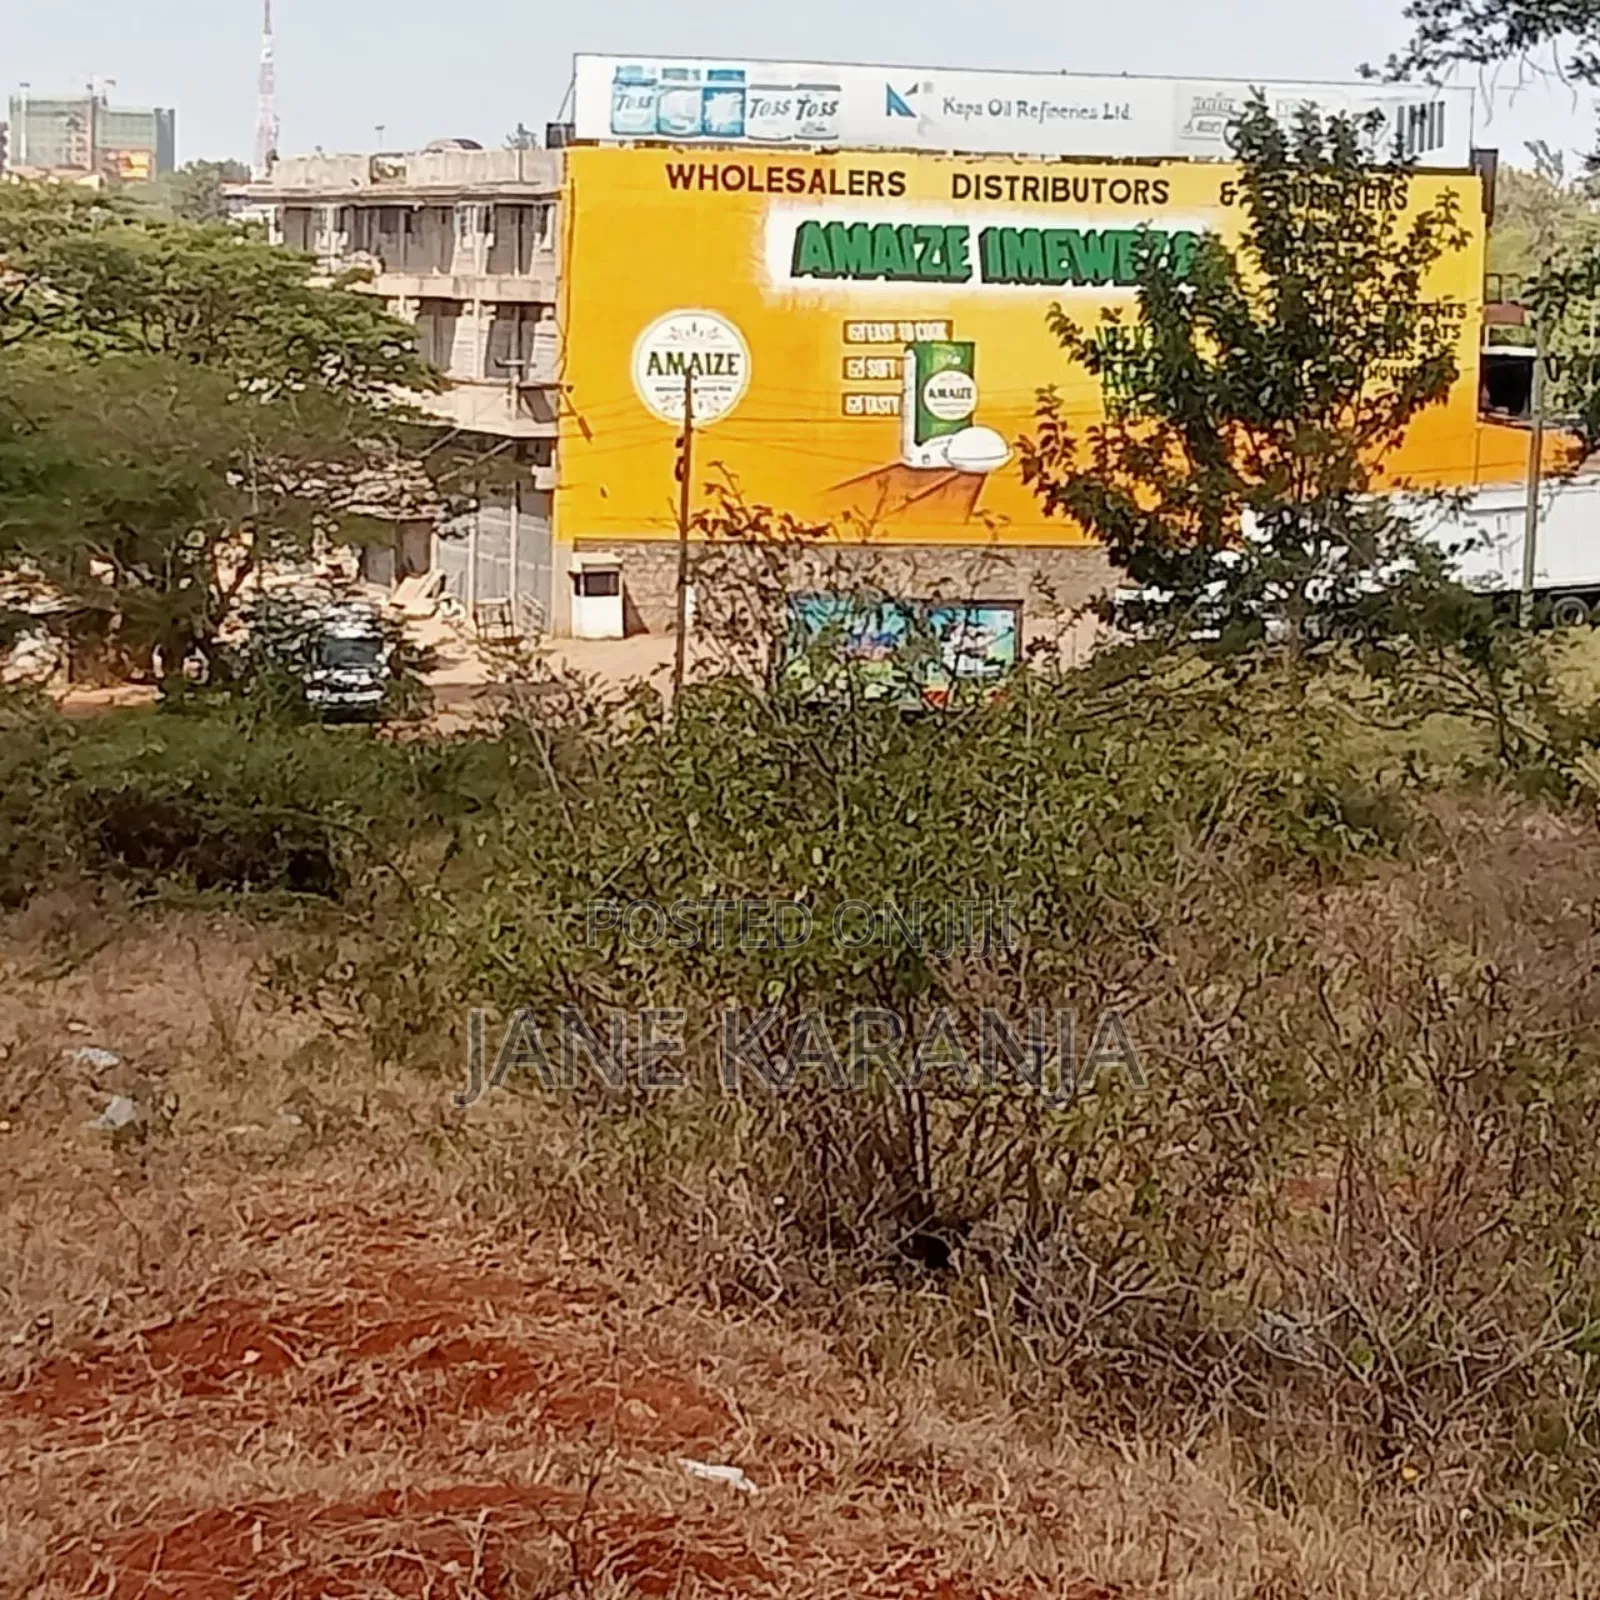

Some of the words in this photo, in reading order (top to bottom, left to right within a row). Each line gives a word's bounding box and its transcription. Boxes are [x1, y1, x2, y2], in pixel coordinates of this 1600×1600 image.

[943, 97, 983, 122] Kapa
[988, 98, 1012, 117] Oil
[1016, 100, 1098, 124] Refineries
[666, 163, 907, 197] WHOLESALERS
[952, 174, 1170, 205] DISTRIBUTORS
[1219, 181, 1238, 206] &
[790, 220, 973, 283] AMAIZE
[646, 350, 741, 376] AMAIZE
[928, 387, 972, 400] AMAIZE
